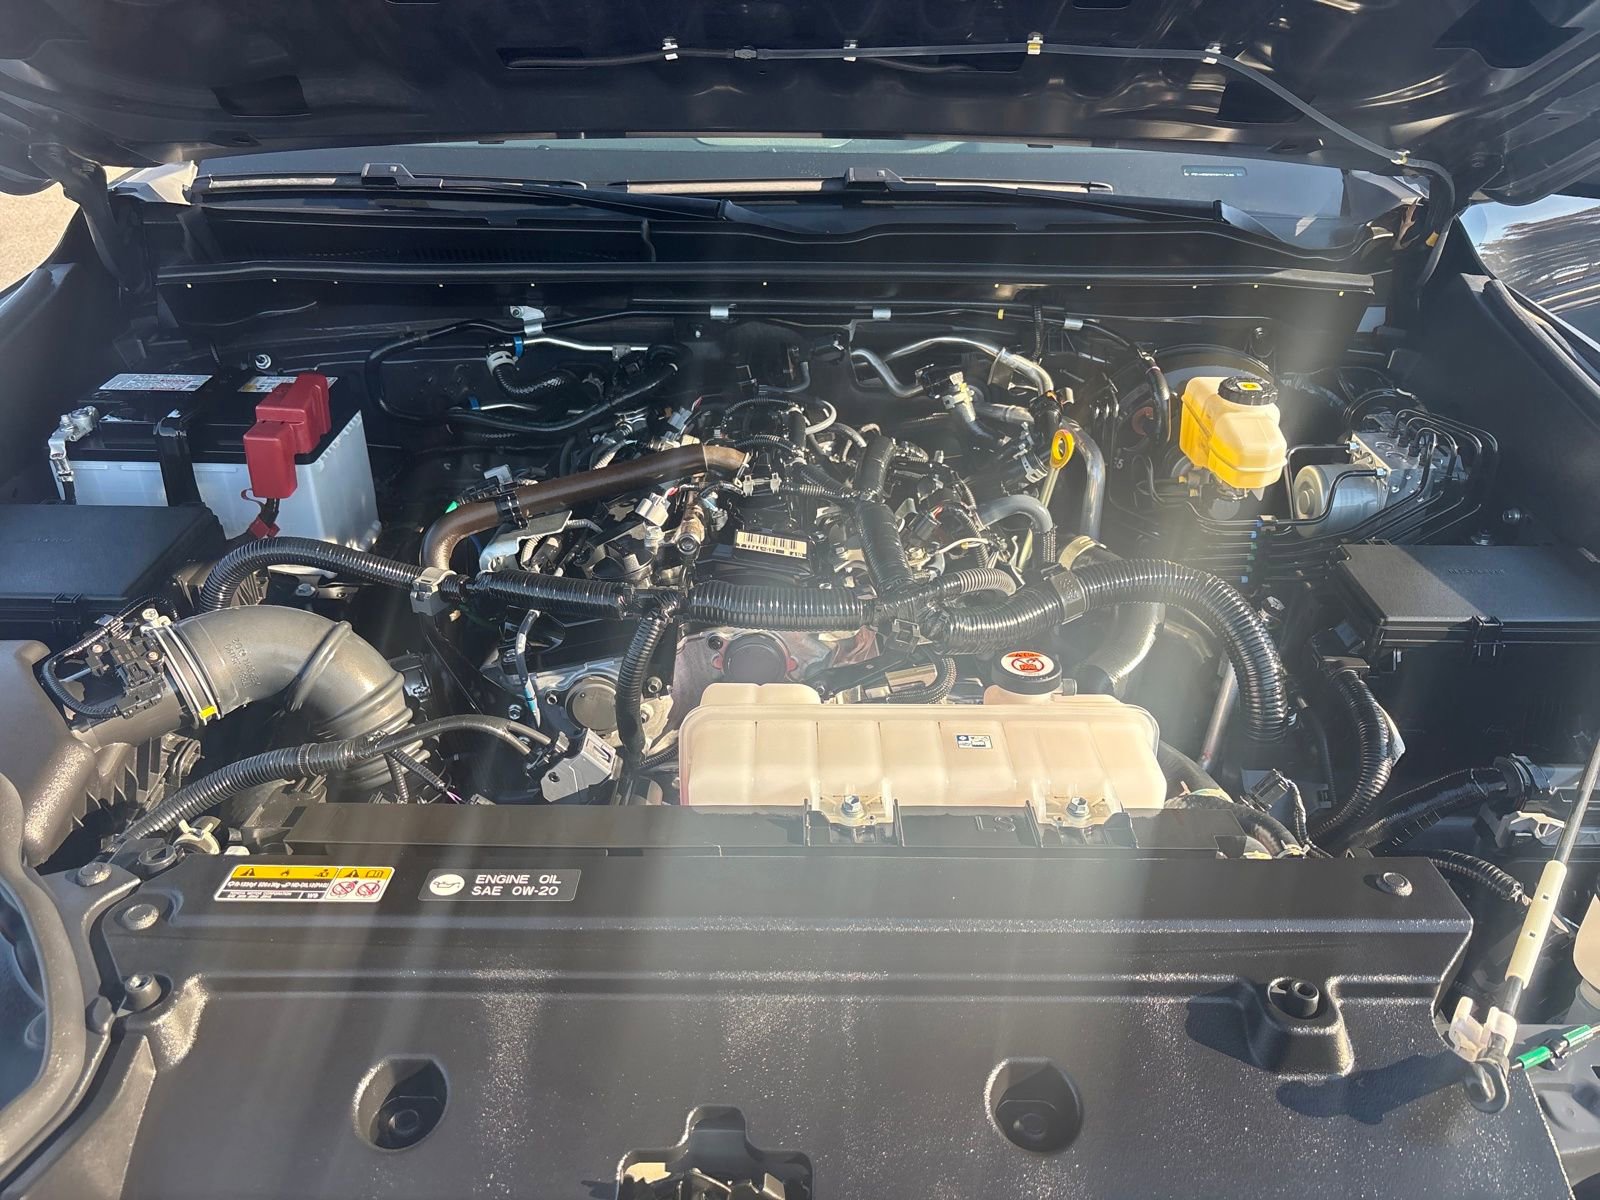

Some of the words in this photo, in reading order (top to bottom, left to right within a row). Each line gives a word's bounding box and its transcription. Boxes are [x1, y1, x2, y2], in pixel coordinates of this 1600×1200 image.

[475, 874, 530, 884] ENGINE
[539, 874, 562, 884] OIL
[471, 886, 503, 896] SAE
[511, 886, 559, 896] 0W-20
